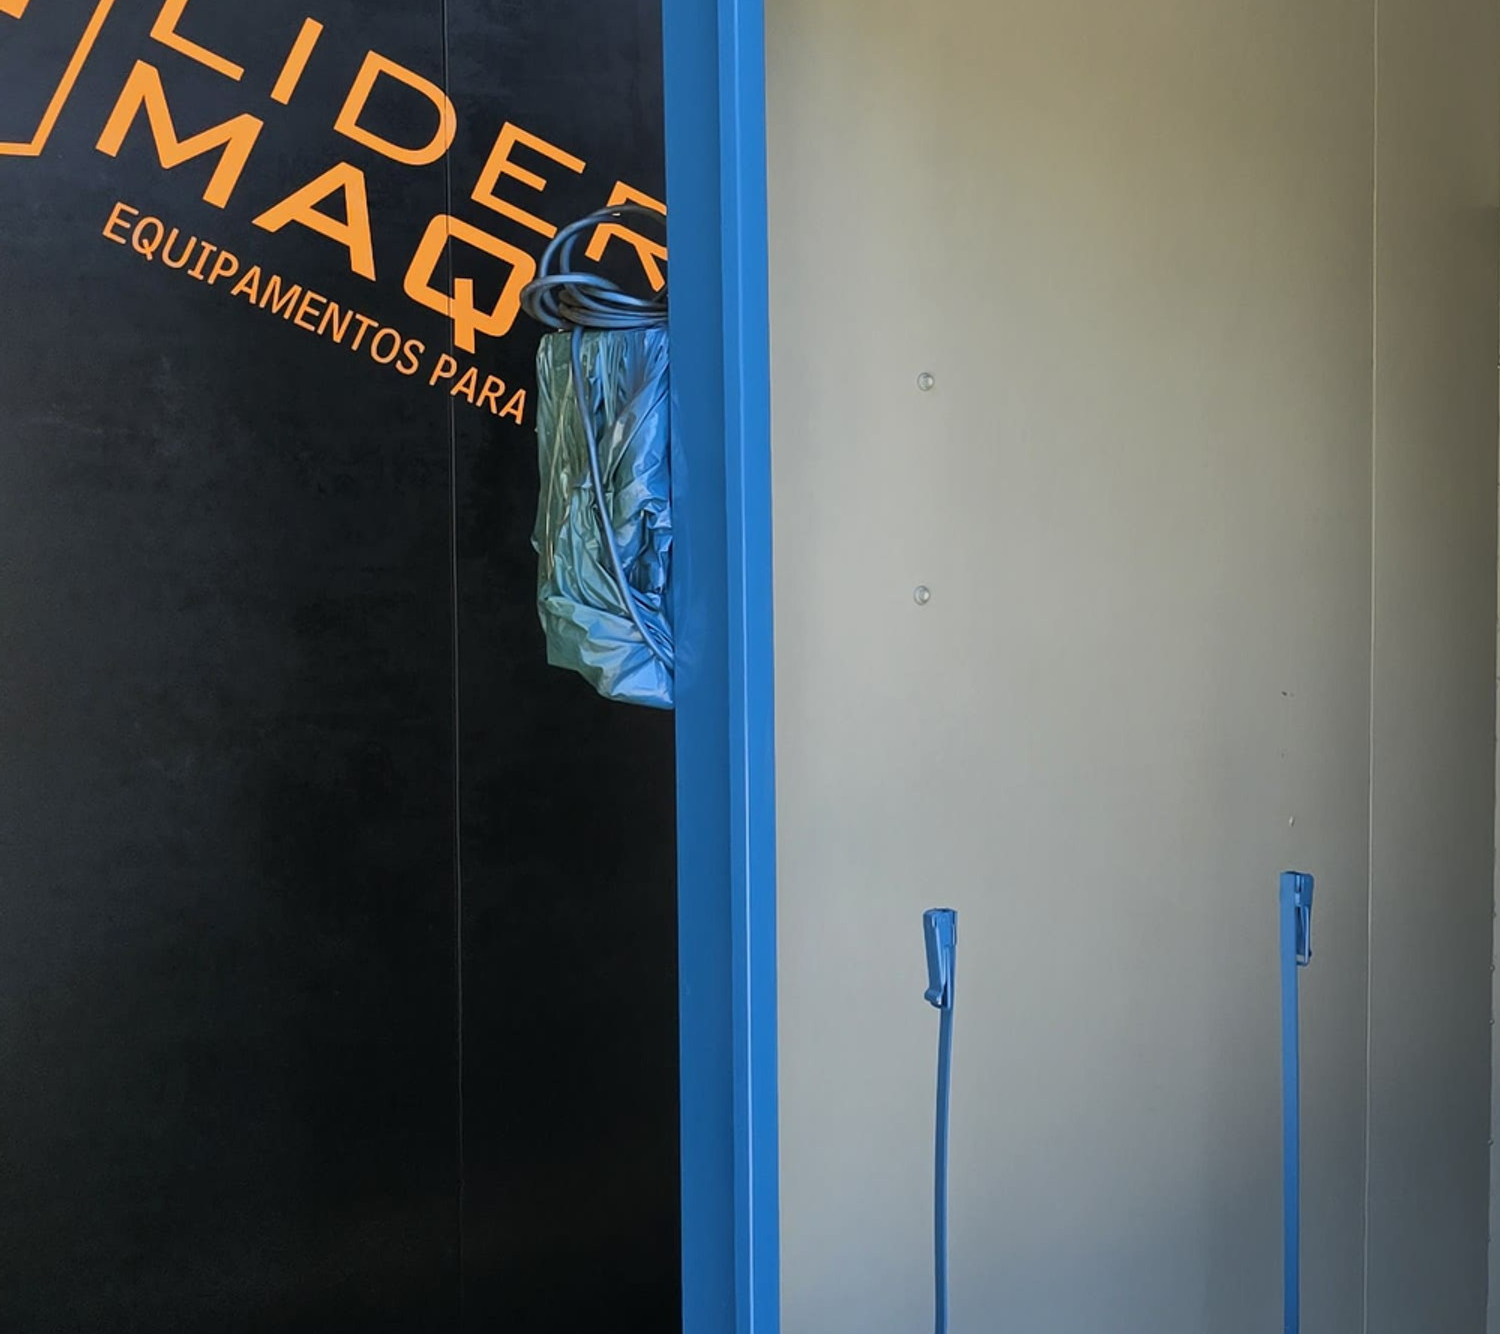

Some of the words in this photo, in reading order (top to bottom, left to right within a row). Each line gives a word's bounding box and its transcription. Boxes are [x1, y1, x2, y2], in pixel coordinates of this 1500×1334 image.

[95, 59, 537, 354] MAQ
[103, 202, 425, 375] EQUIPAMENTOS
[429, 353, 527, 425] PARA
